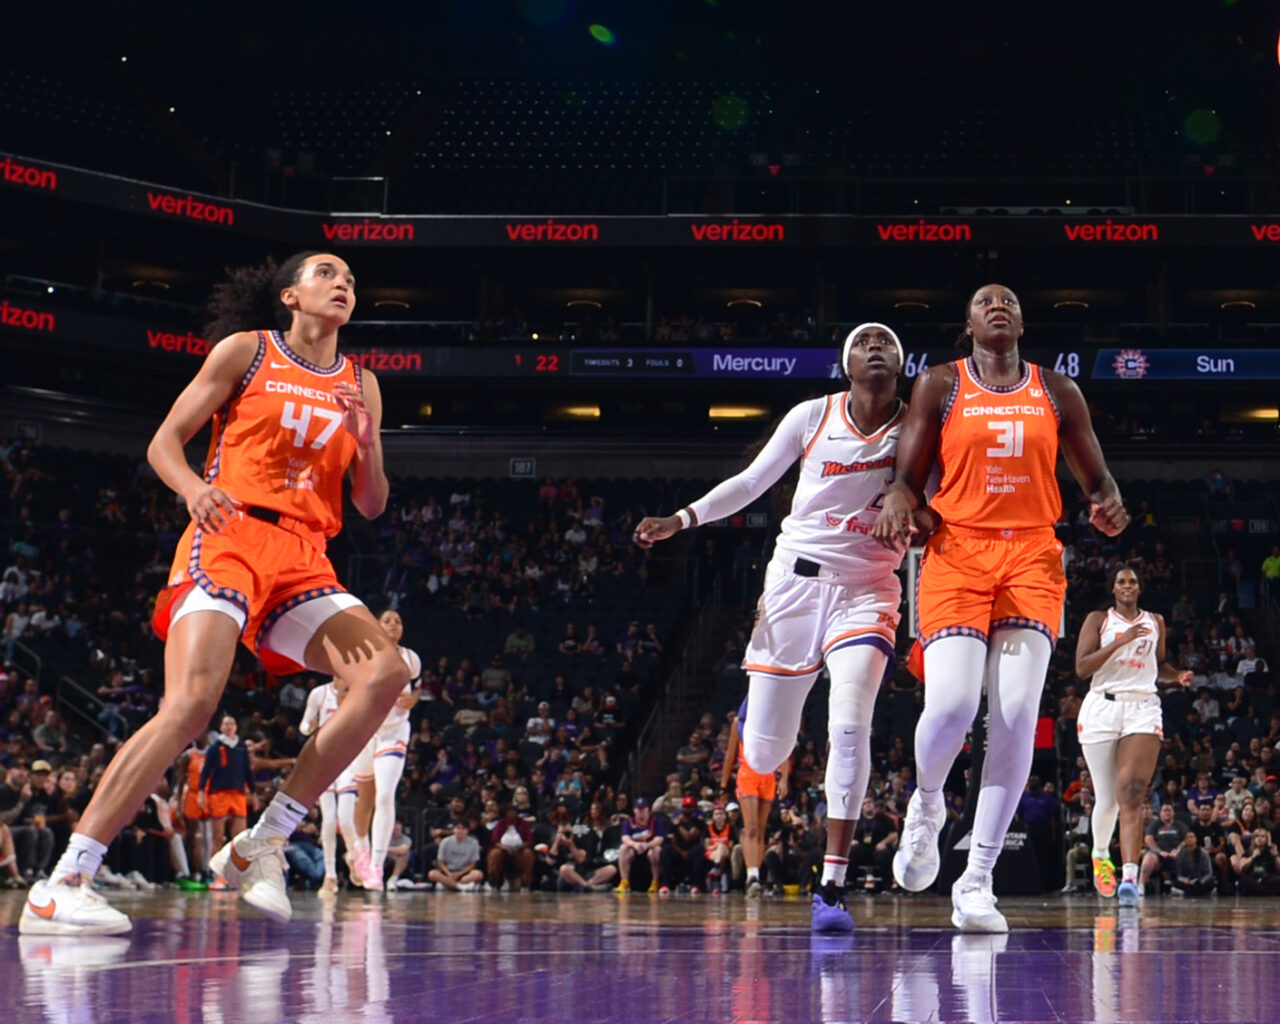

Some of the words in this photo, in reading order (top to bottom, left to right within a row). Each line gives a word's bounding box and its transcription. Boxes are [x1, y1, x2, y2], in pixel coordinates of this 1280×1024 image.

[147, 192, 235, 225] verizon
[323, 219, 415, 241] verizon
[506, 219, 599, 241] verizon
[691, 219, 785, 241] verizon
[877, 219, 972, 241] verizon
[1064, 219, 1159, 241] verizon
[536, 355, 559, 372] 22
[713, 354, 797, 375] Mercury
[1053, 352, 1080, 377] 48
[1197, 355, 1235, 373] Sun
[963, 405, 1045, 417] CONNECTICUT
[280, 401, 343, 450] 47
[986, 421, 1024, 458] 31
[986, 465, 1002, 474] Yale
[986, 475, 1030, 484] NewHaven
[986, 484, 1016, 493] Health
